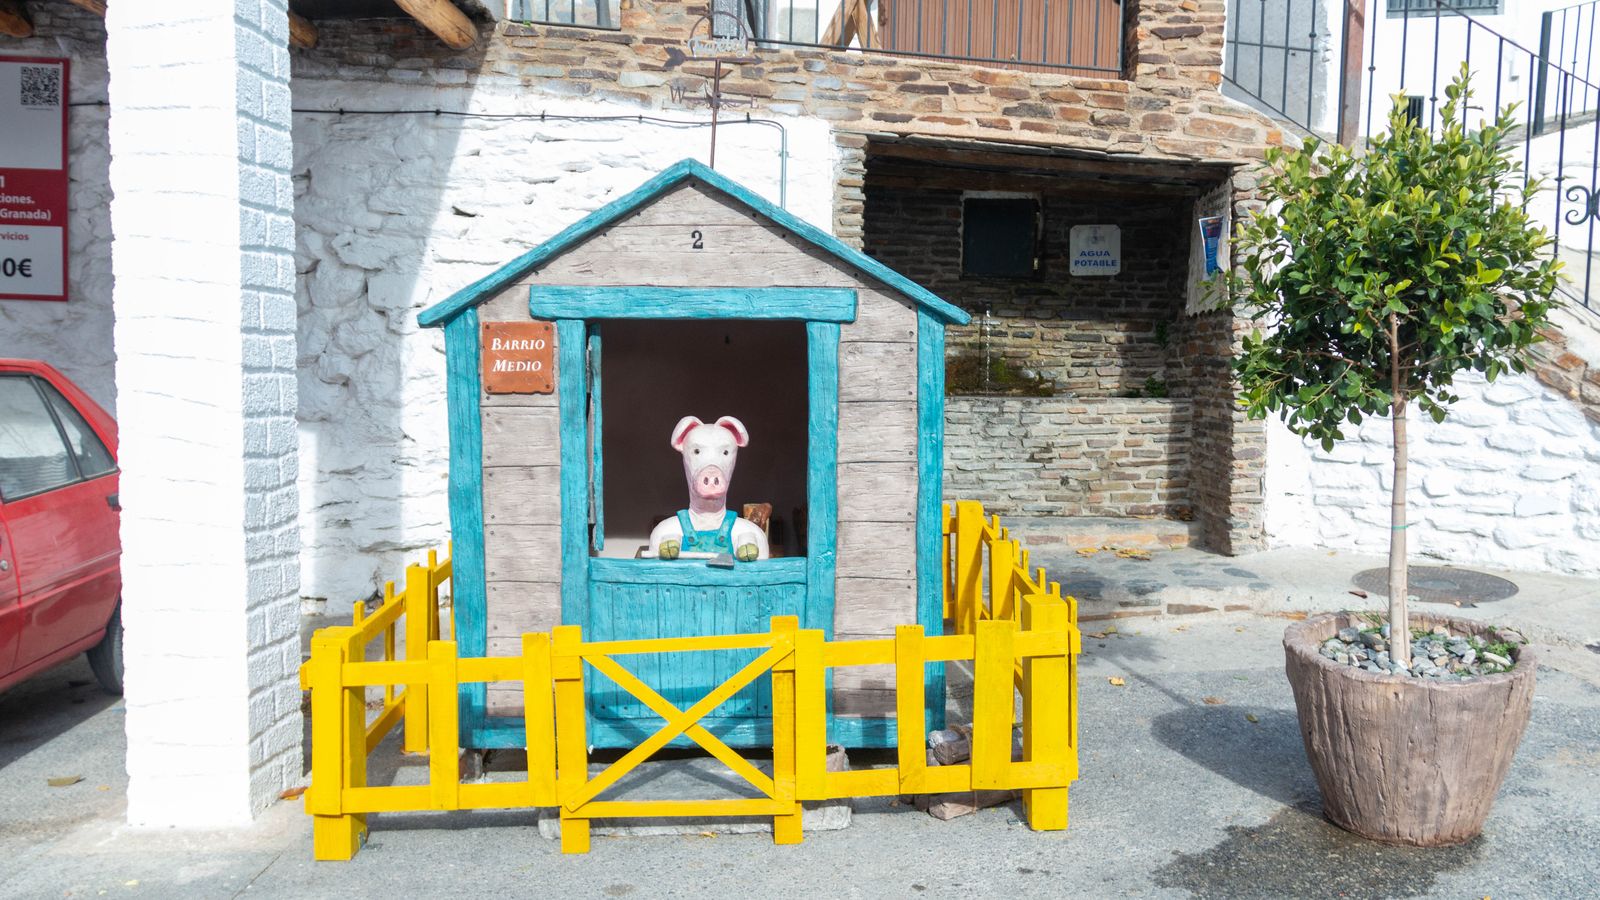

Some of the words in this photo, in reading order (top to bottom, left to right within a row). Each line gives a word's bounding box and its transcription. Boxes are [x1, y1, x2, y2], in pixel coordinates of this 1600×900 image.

[0, 193, 35, 204] iones.
[691, 229, 704, 250] 2
[0, 257, 33, 278] 0€
[1074, 259, 1118, 267] POTABLE
[491, 337, 546, 351] BARRIO
[492, 359, 542, 373] MEDIO
